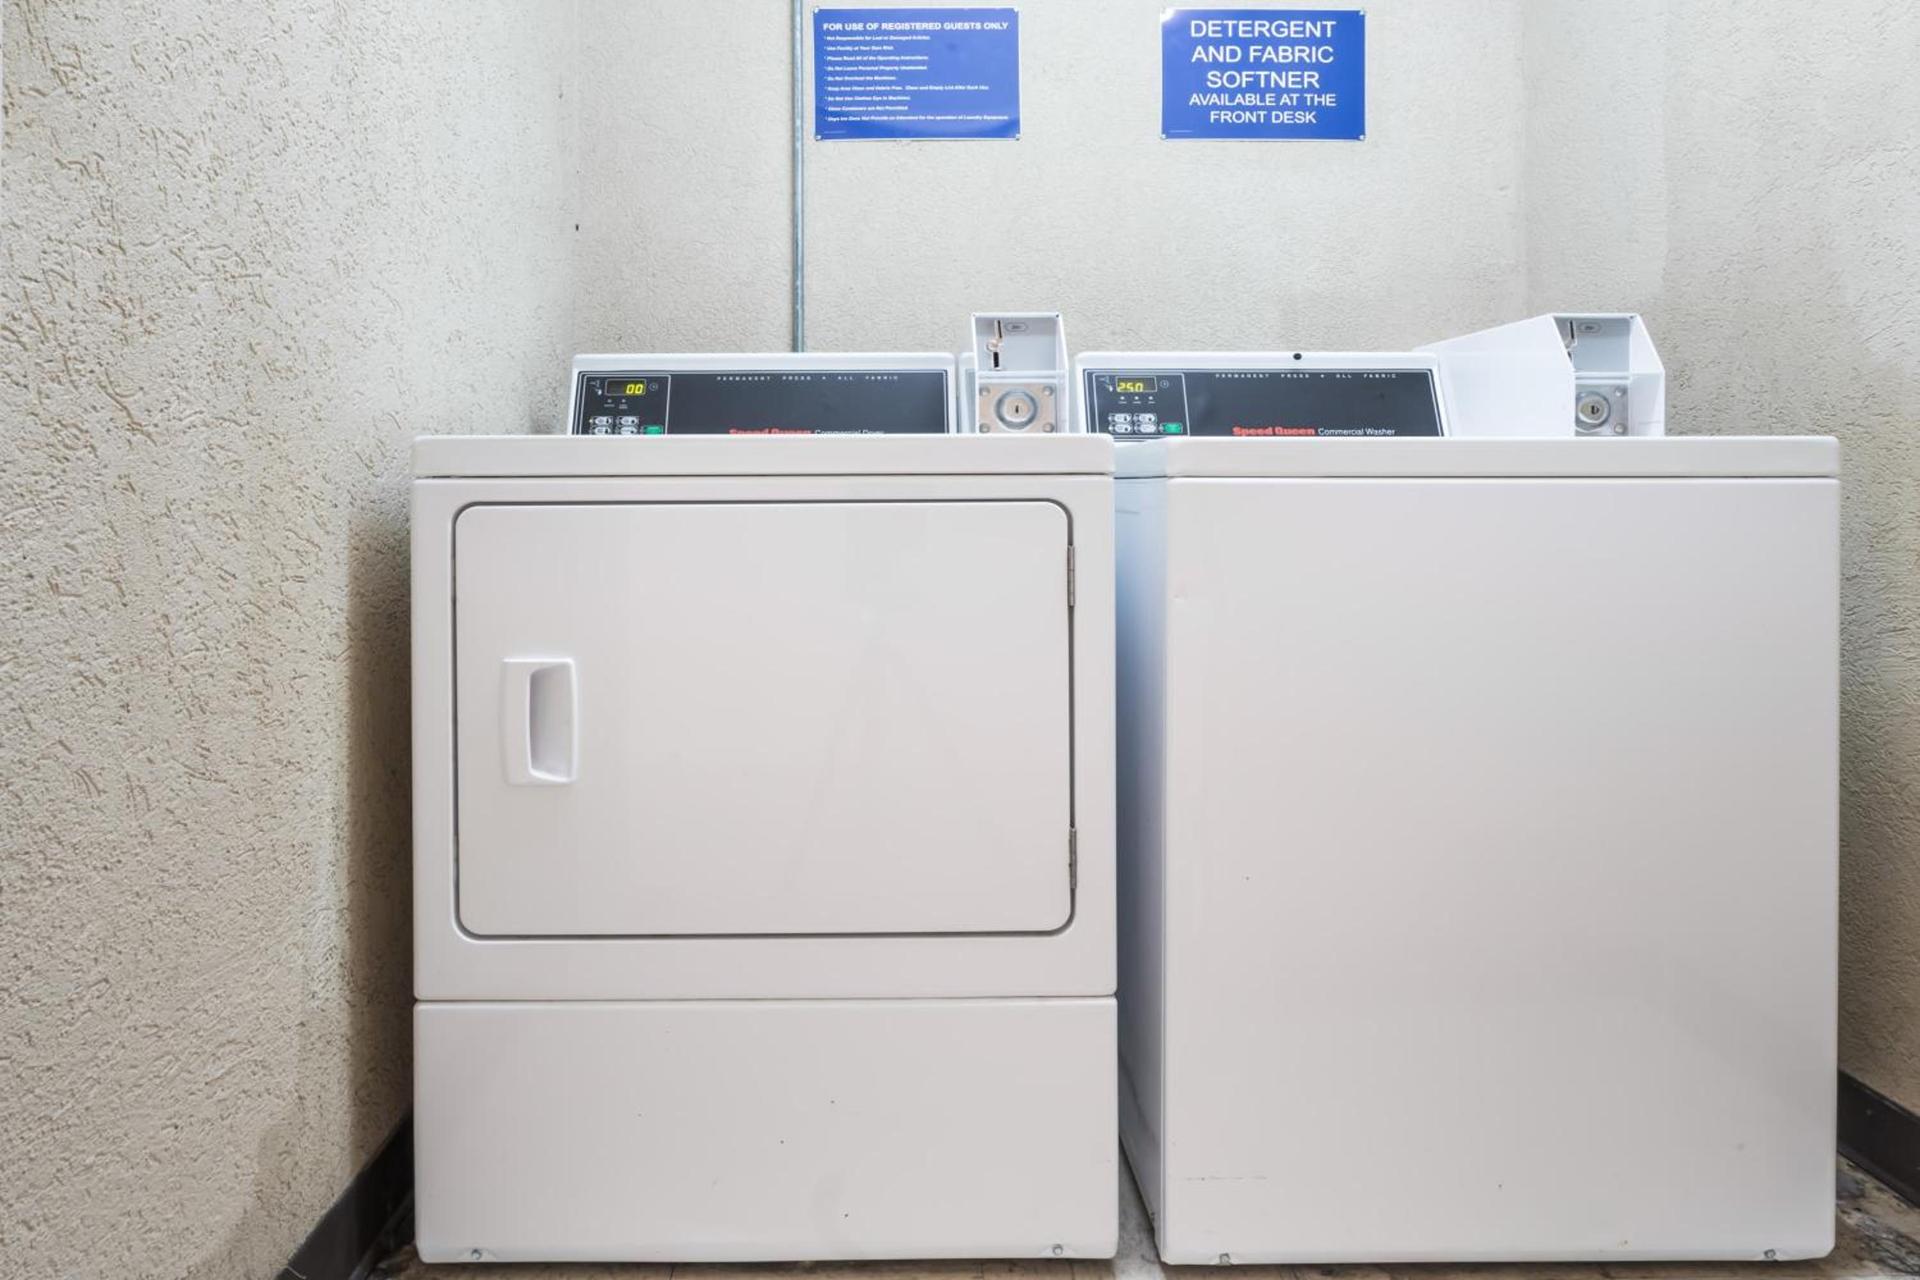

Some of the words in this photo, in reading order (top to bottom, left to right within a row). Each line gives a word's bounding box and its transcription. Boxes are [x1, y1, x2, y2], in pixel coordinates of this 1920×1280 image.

[823, 22, 842, 31] FOR
[845, 22, 864, 31] USE
[866, 22, 880, 31] OF
[882, 22, 941, 31] REGISTERED
[944, 22, 982, 31] GUESTS
[984, 22, 1008, 31] ONLY
[1190, 20, 1336, 38] DETERGENT
[1191, 46, 1242, 62] AND
[1249, 46, 1334, 62] FABRIC
[1206, 71, 1320, 88] SOFTNER
[1189, 94, 1276, 106] AVAILABLE
[1280, 94, 1302, 106] AT
[1304, 94, 1336, 106] THE
[1210, 111, 1267, 123] FRONT
[1272, 111, 1316, 123] DESK
[626, 384, 644, 394] 00
[1232, 426, 1272, 436] Speed
[1275, 426, 1315, 435] Queen
[1318, 428, 1364, 436] Commercial
[1365, 428, 1395, 436] Washer
